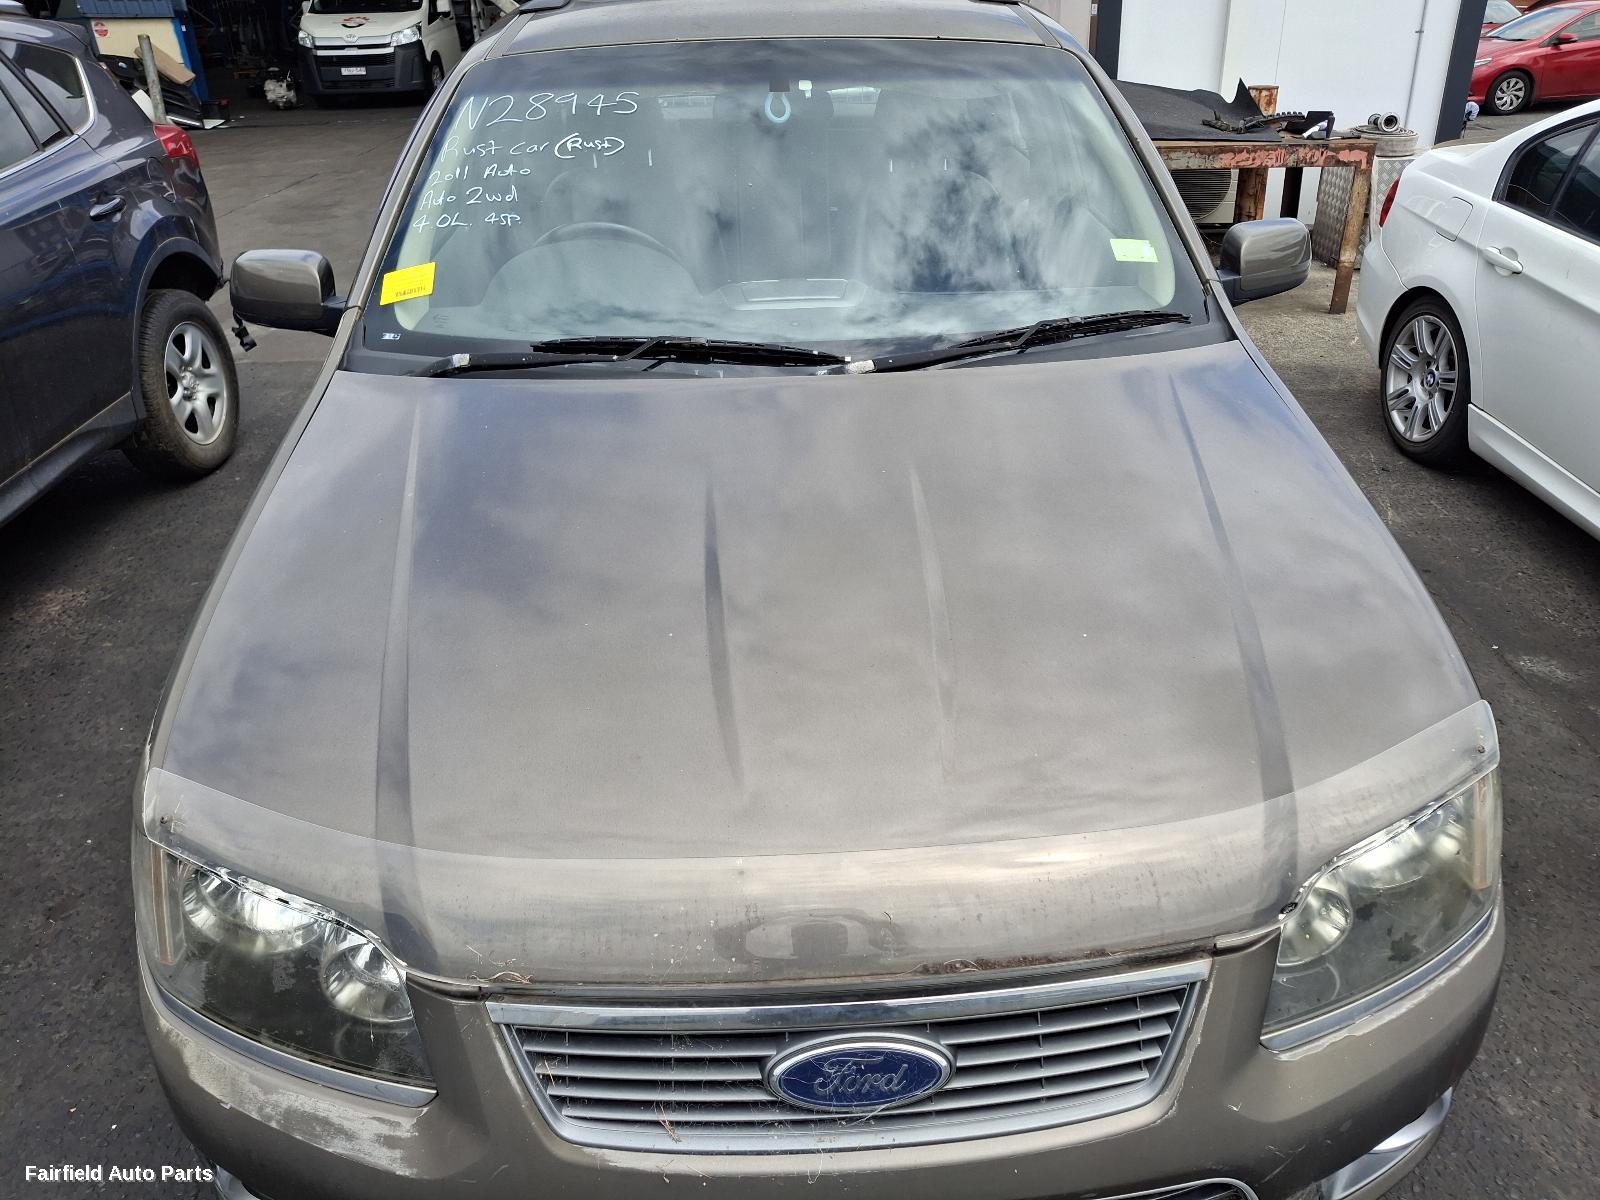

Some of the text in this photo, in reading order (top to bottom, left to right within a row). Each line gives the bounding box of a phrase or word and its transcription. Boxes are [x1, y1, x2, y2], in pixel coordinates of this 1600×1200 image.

[454, 91, 640, 130] N28945
[440, 135, 503, 163] Rust
[483, 163, 531, 179] Auto
[419, 189, 456, 210] Auto
[813, 1056, 910, 1096] Ford
